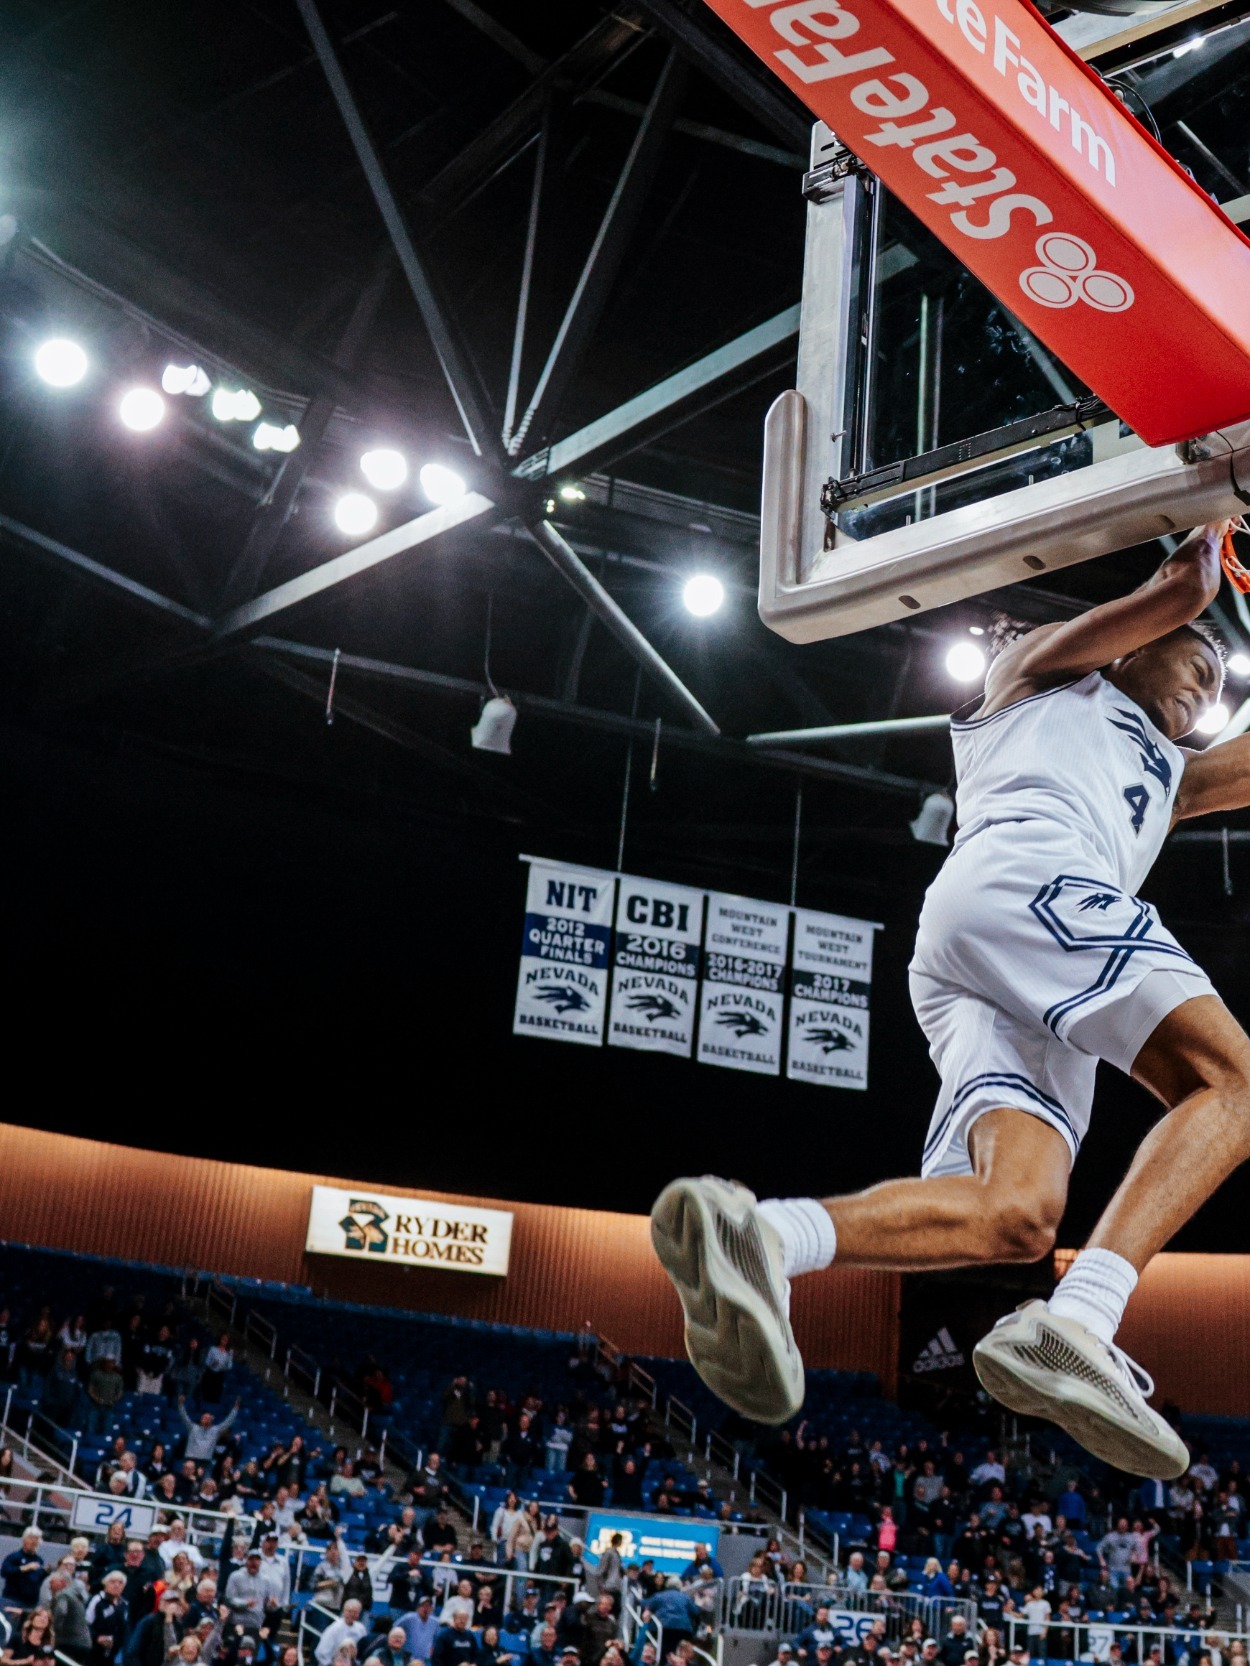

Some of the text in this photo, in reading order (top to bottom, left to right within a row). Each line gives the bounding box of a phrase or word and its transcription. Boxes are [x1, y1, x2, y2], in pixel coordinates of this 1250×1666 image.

[1123, 784, 1151, 836] 4
[546, 880, 597, 912] NIT
[626, 895, 690, 932] CBI
[719, 908, 777, 926] MOUNTAIN
[546, 918, 586, 937] 2012
[732, 924, 763, 937] WEST
[806, 925, 863, 943] MOUNTAIN
[529, 928, 605, 955] QUARTER
[626, 935, 686, 960] 2016
[712, 934, 780, 953] CONFERENCE
[818, 940, 849, 954] WEST
[540, 946, 593, 964] FINALS
[616, 951, 696, 976] CHAMPIONS
[708, 954, 782, 977] 2016-2017
[798, 951, 867, 970] TOURNAMENT
[526, 967, 599, 996] NEVADA
[709, 968, 778, 990] CHAMPIONS
[813, 974, 850, 991] 2017
[618, 976, 689, 1005] NEVADA
[794, 984, 868, 1008] CHAMPIONS
[707, 994, 776, 1021] NEVADA
[519, 1014, 599, 1034] BASKETBALL
[613, 1022, 688, 1043] BASKETBALL
[795, 1011, 863, 1038] NEVADA
[702, 1043, 775, 1065] BASKETBALL
[792, 1059, 863, 1080] BASKETBALL
[394, 1214, 488, 1244] RYDER
[391, 1237, 484, 1265] HOMES
[913, 1352, 965, 1373] adidas
[95, 1503, 132, 1528] 24
